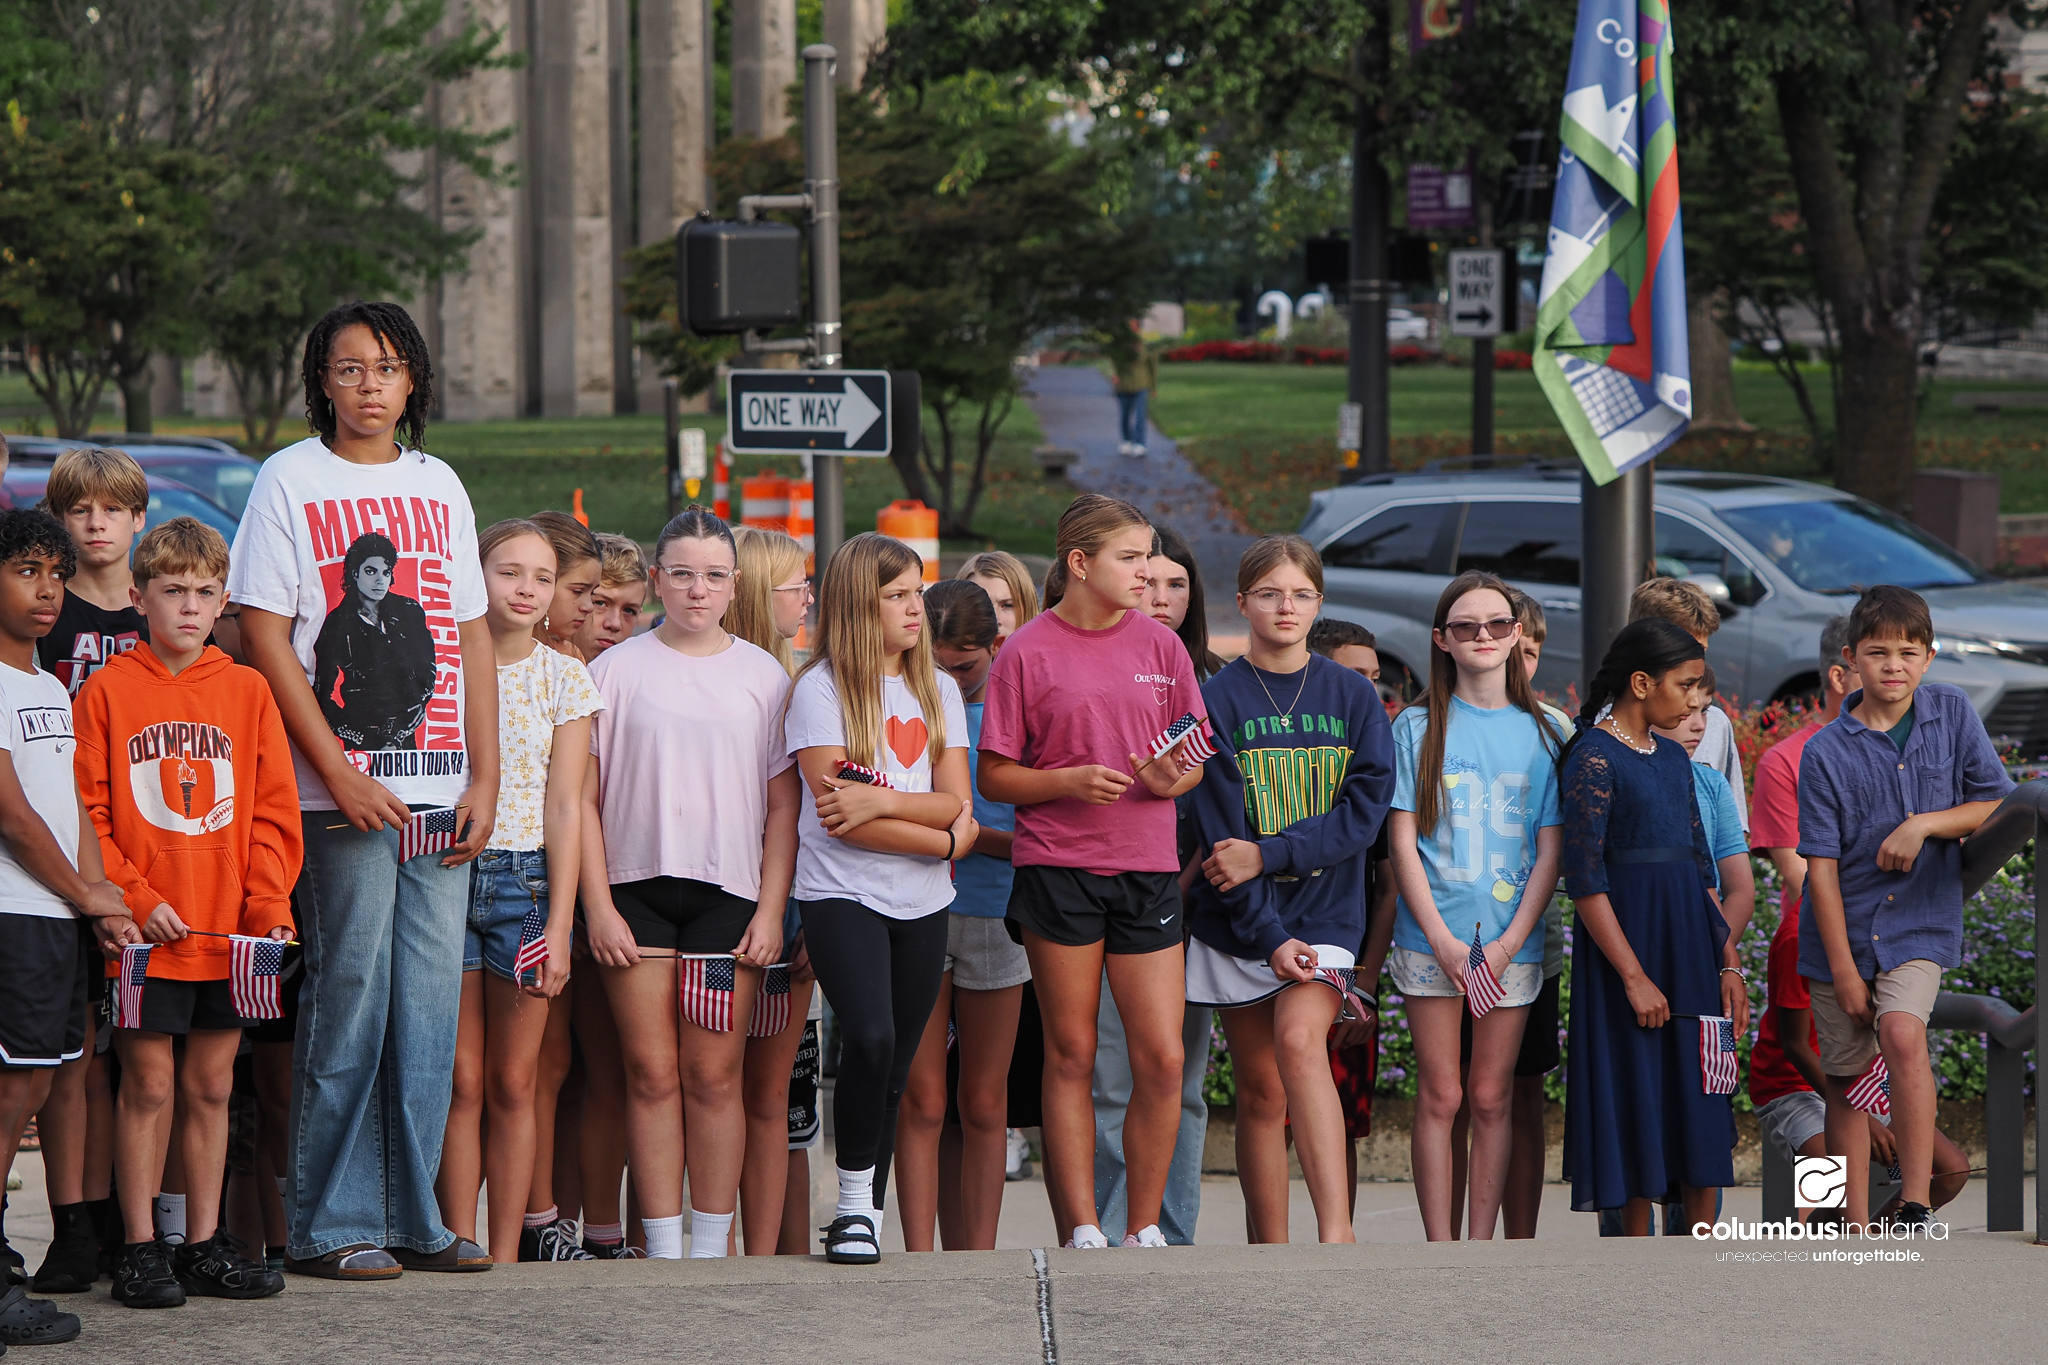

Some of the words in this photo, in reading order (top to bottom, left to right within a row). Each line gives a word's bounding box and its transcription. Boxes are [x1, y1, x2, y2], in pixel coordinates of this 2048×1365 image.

[1457, 257, 1493, 278] ONE
[1457, 282, 1494, 299] WAY
[749, 397, 791, 426] ONE
[800, 398, 842, 426] WAY
[303, 496, 454, 563] MICHAEL
[420, 558, 465, 751] JACKSON
[1302, 714, 1349, 739] DAM
[127, 721, 233, 766] OLYMPIANS
[369, 752, 418, 777] WORLD
[421, 752, 450, 776] TOUR
[789, 1110, 806, 1121] SAINT
